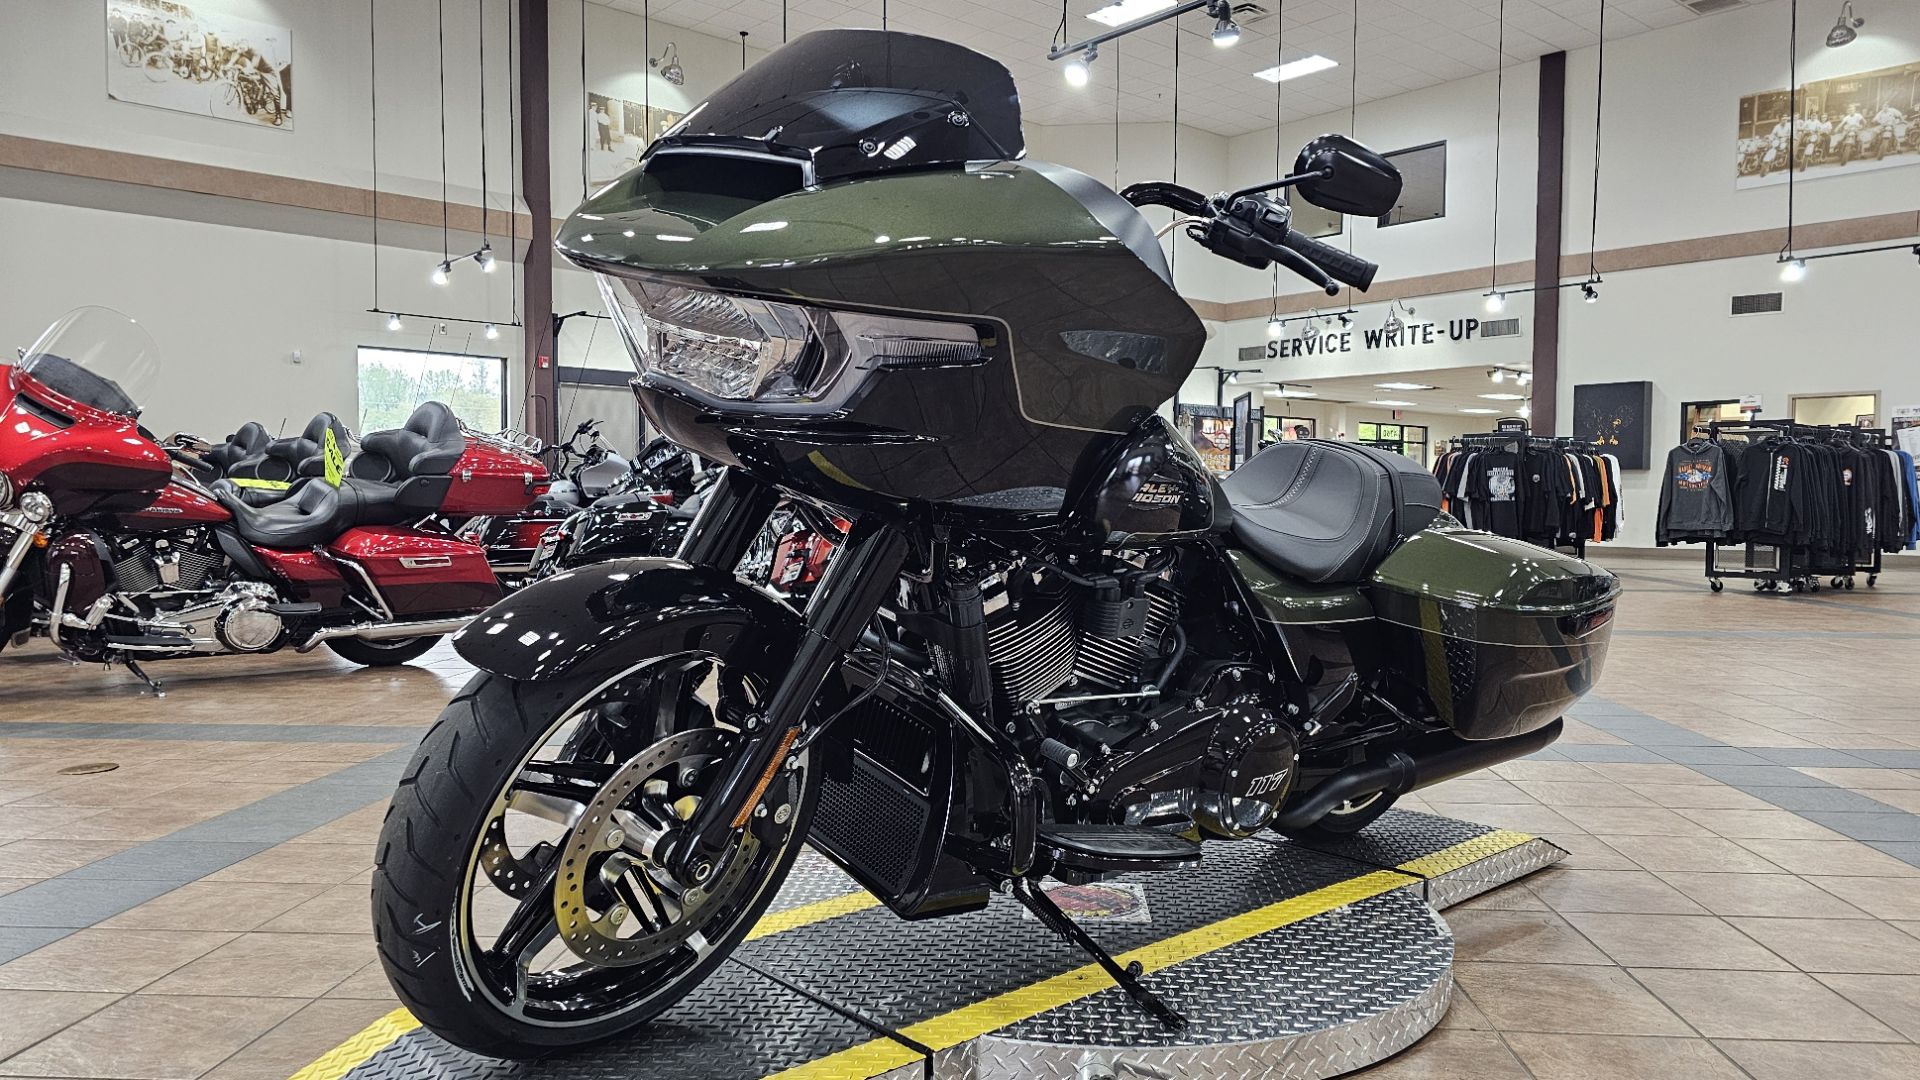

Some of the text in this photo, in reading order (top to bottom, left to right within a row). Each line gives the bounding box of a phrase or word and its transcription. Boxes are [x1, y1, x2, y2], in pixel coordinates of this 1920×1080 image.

[1267, 318, 1479, 359] SERVICE WRITE-UP
[1245, 768, 1289, 797] 117
